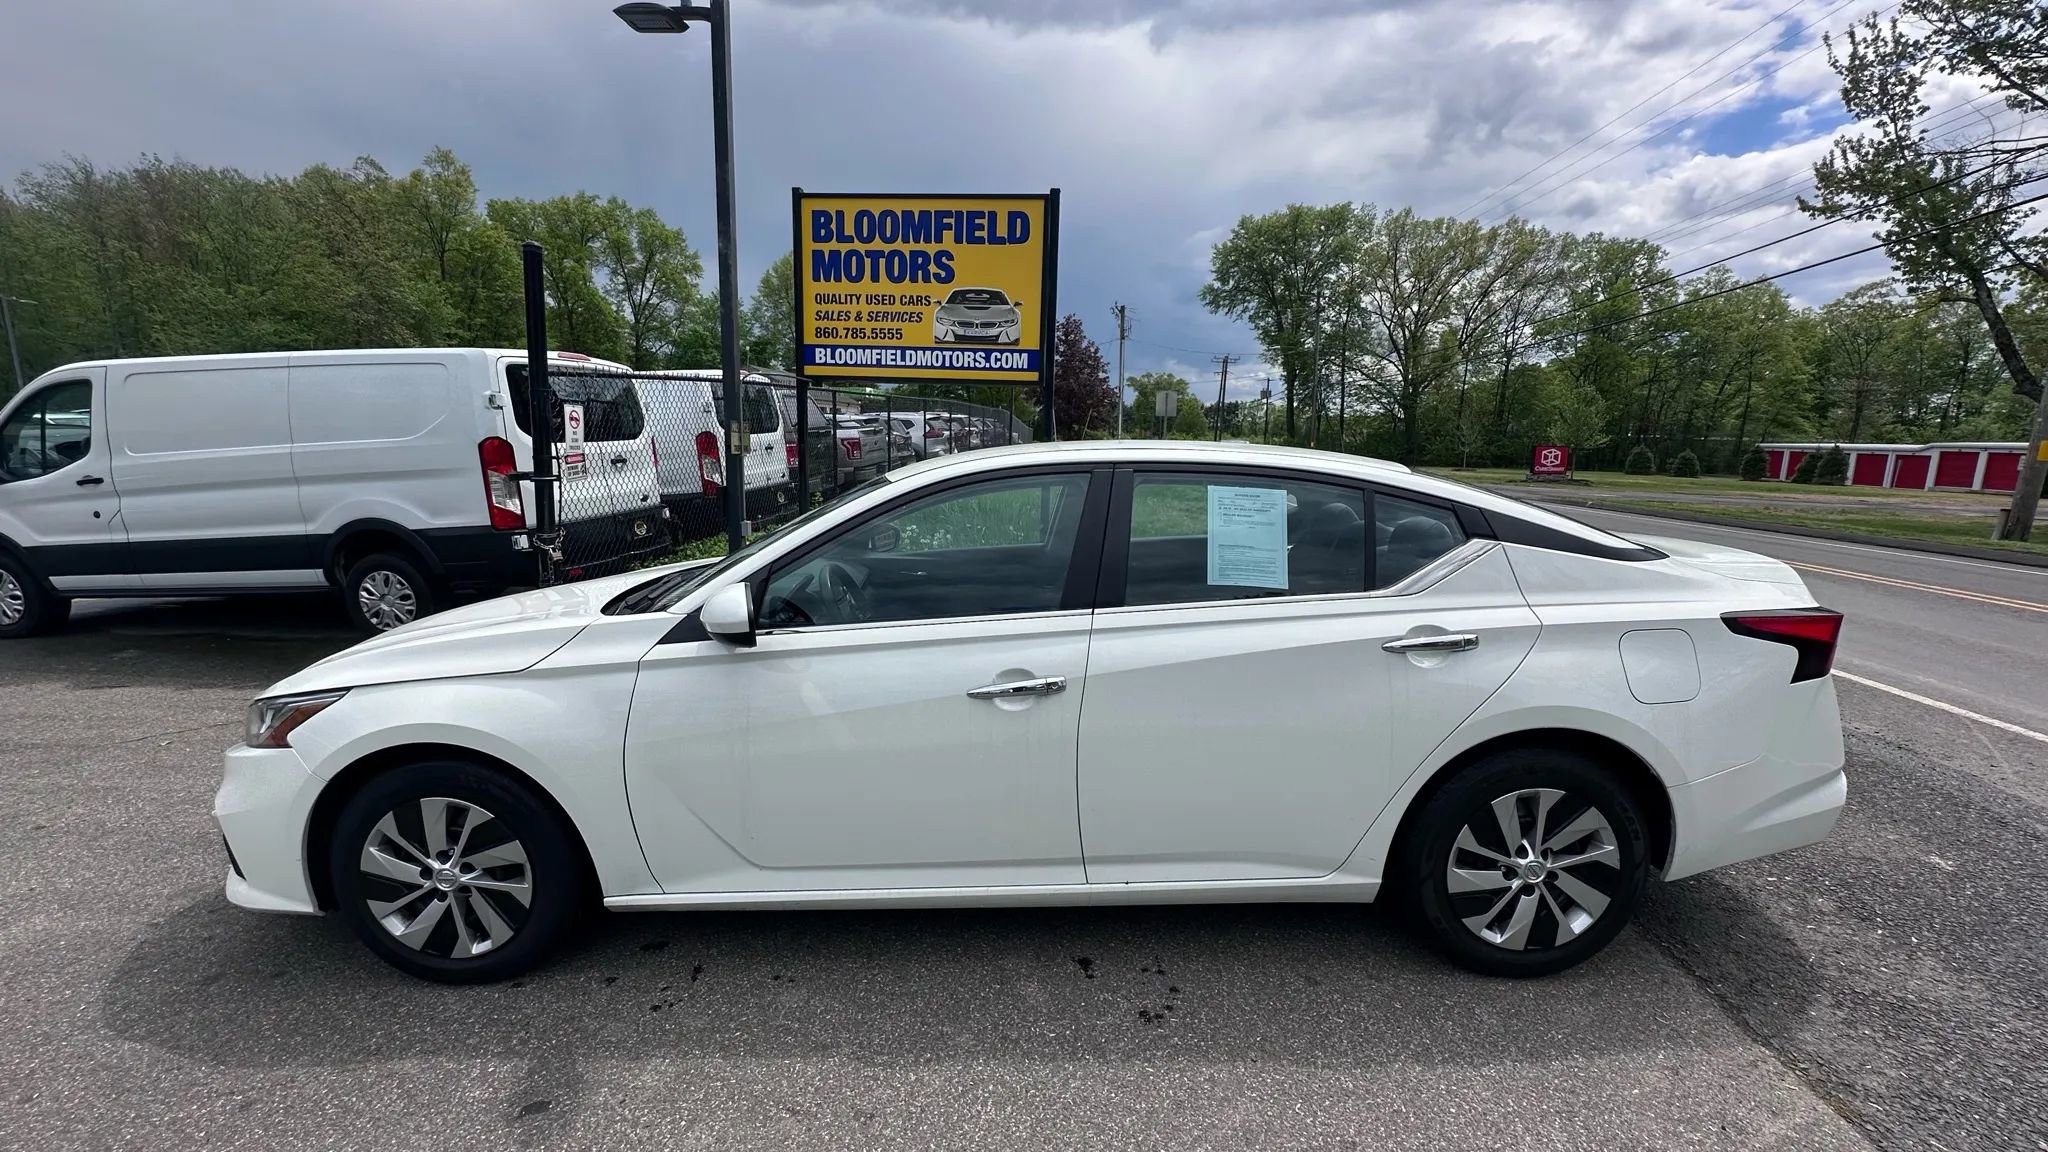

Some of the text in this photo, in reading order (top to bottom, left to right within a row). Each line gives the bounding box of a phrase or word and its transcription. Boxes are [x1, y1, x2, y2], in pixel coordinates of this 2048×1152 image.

[811, 209, 1031, 245] BLOOMFIELD
[811, 249, 956, 284] MOTORS
[814, 293, 932, 307] QUALITY USED CARS
[814, 310, 924, 324] SALES & SERVICES
[814, 326, 903, 341] 860.785.5555
[815, 347, 1028, 370] BLOOMFIELDMOTORS.COM
